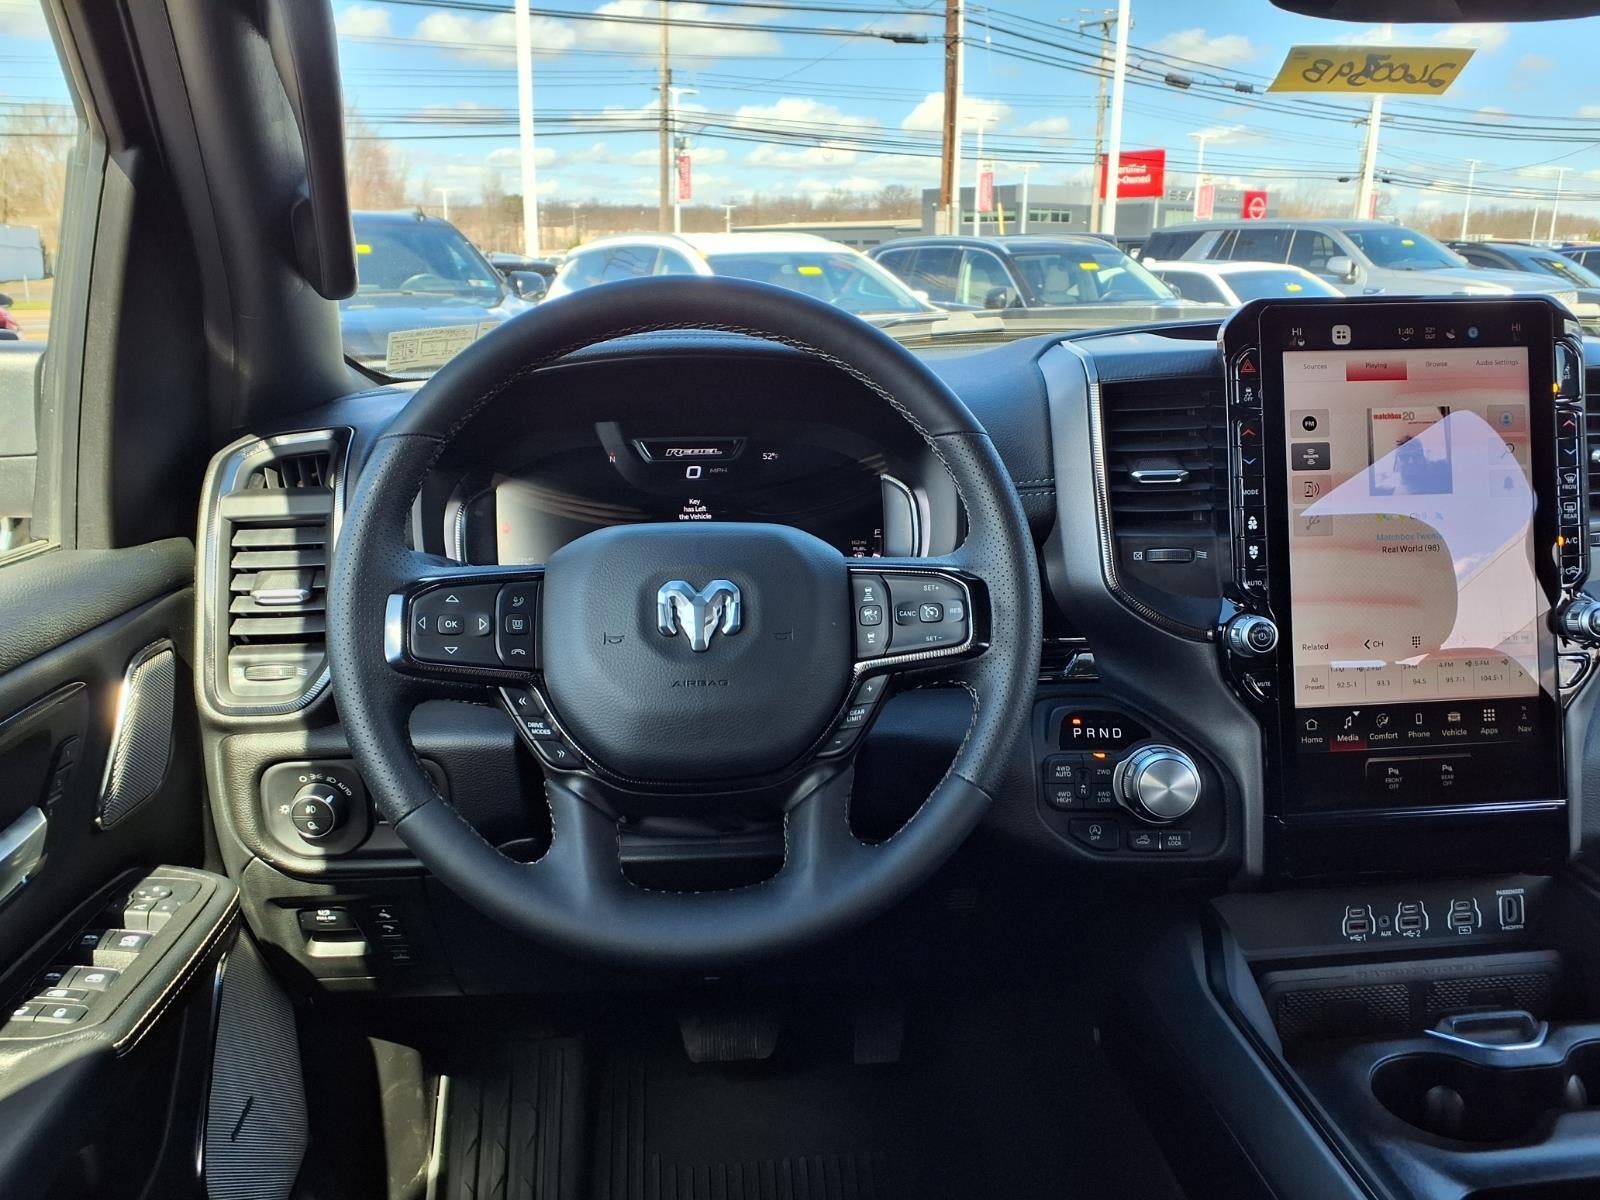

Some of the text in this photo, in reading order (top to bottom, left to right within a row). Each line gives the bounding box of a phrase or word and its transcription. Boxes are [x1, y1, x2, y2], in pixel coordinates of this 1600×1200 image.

[1117, 164, 1147, 174] ertified
[1291, 327, 1302, 336] HI
[1397, 327, 1414, 335] 1:40
[1511, 323, 1521, 332] HI
[1365, 362, 1388, 370] Playing
[1475, 358, 1519, 367] Audio Settings
[1373, 411, 1415, 421] matchbox 20
[1376, 533, 1413, 542] Matchbox
[1400, 545, 1423, 553] World
[445, 620, 458, 628] OK
[1302, 643, 1329, 651] Related
[1372, 640, 1384, 648] CH
[672, 679, 729, 687] AIRBAG
[1408, 730, 1430, 738] Phone
[1441, 728, 1467, 736] Vehicle
[1480, 727, 1498, 735] Apps
[1301, 736, 1323, 744] Home
[1337, 734, 1359, 742] Media
[1369, 732, 1398, 740] Comfort
[337, 782, 352, 796] AUTO
